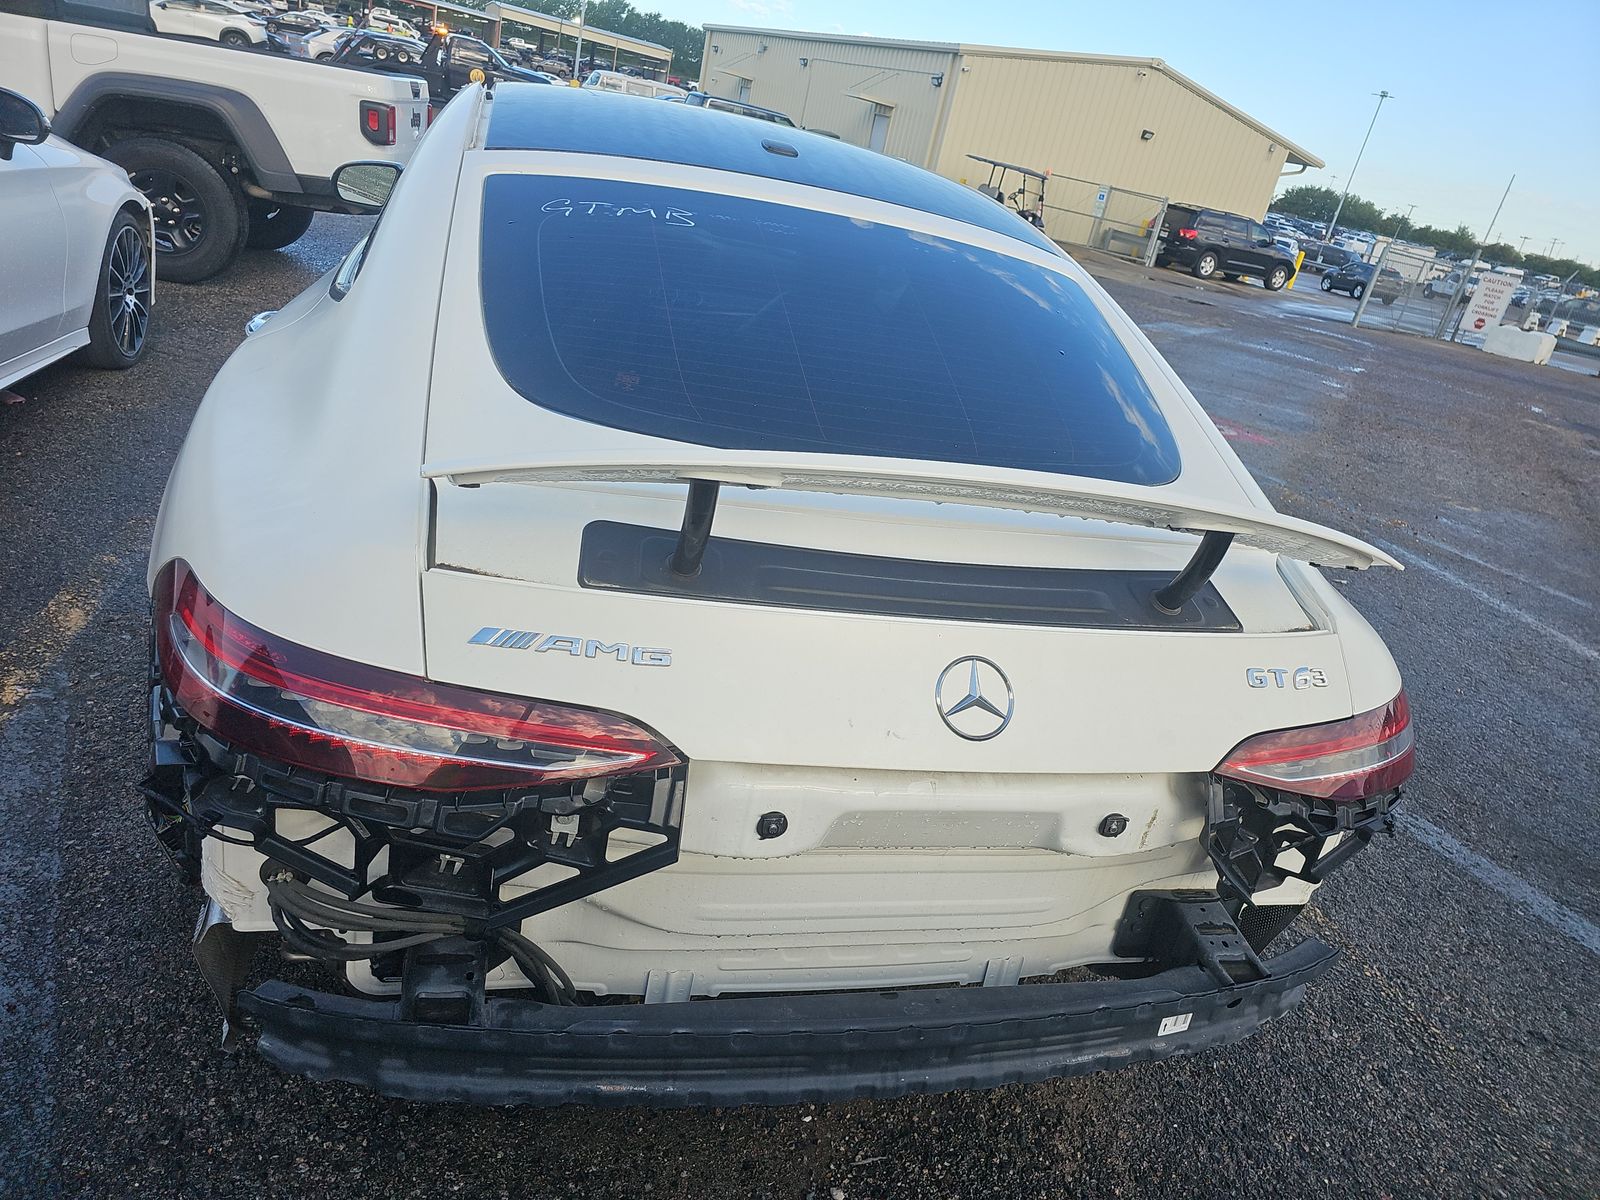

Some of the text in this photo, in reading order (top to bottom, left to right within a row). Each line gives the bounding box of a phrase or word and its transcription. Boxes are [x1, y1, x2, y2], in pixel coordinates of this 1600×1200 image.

[1483, 277, 1512, 287] CAUTION
[1471, 310, 1497, 319] CROSSING
[535, 634, 673, 668] AMG
[1246, 666, 1329, 690] GT 63
